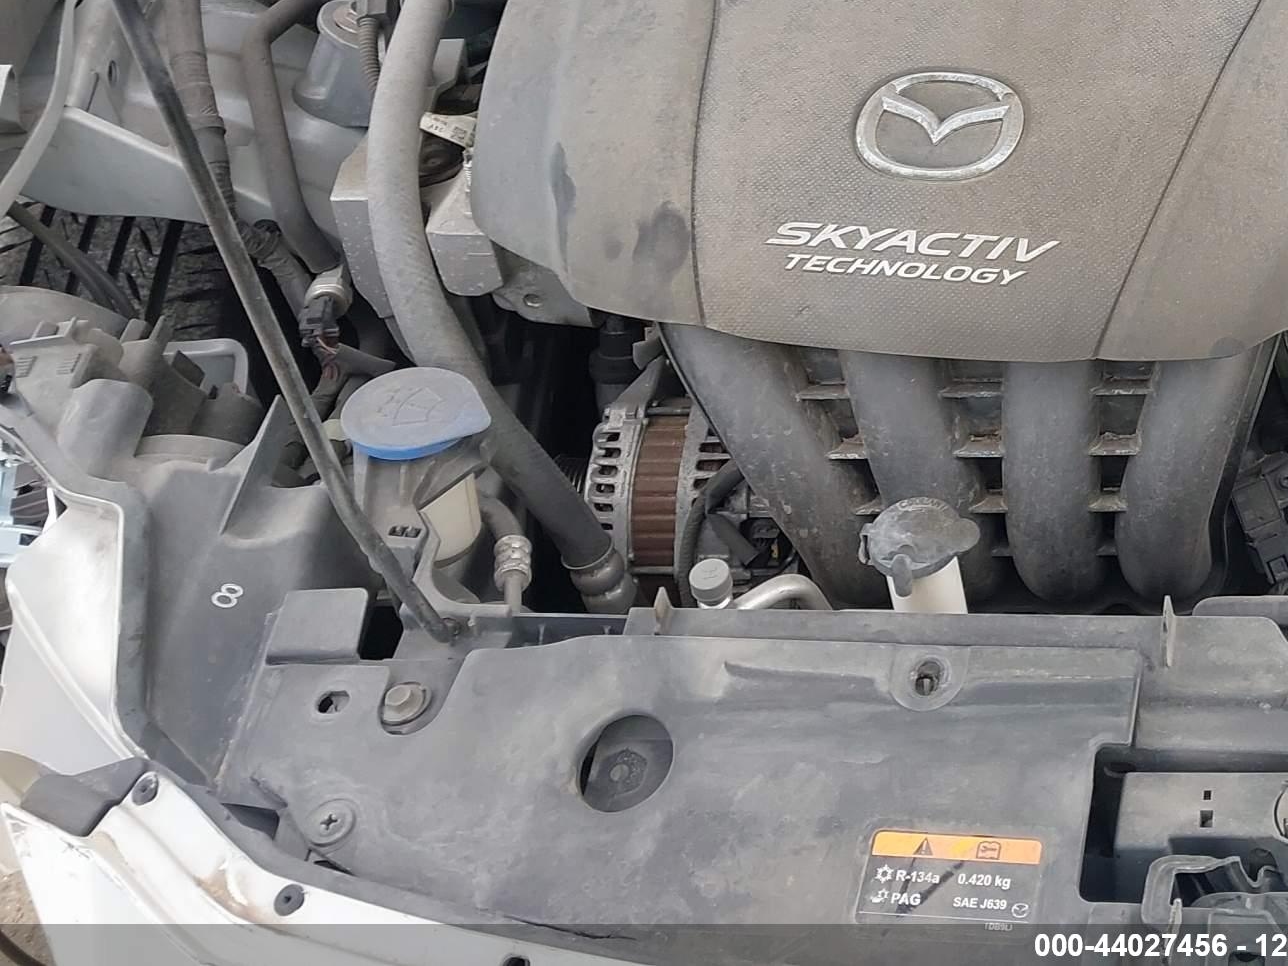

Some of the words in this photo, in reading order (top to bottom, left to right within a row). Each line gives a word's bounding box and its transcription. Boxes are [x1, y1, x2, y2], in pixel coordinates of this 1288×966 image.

[764, 221, 1061, 263] SKYACTIV
[784, 253, 1029, 285] TECHNOLOGY
[211, 583, 244, 608] 8
[896, 870, 940, 884] R-134a
[957, 873, 992, 886] 0.420
[995, 875, 1012, 890] kg
[891, 893, 921, 906] PAG
[953, 897, 978, 908] SAE
[980, 899, 1007, 910] J639
